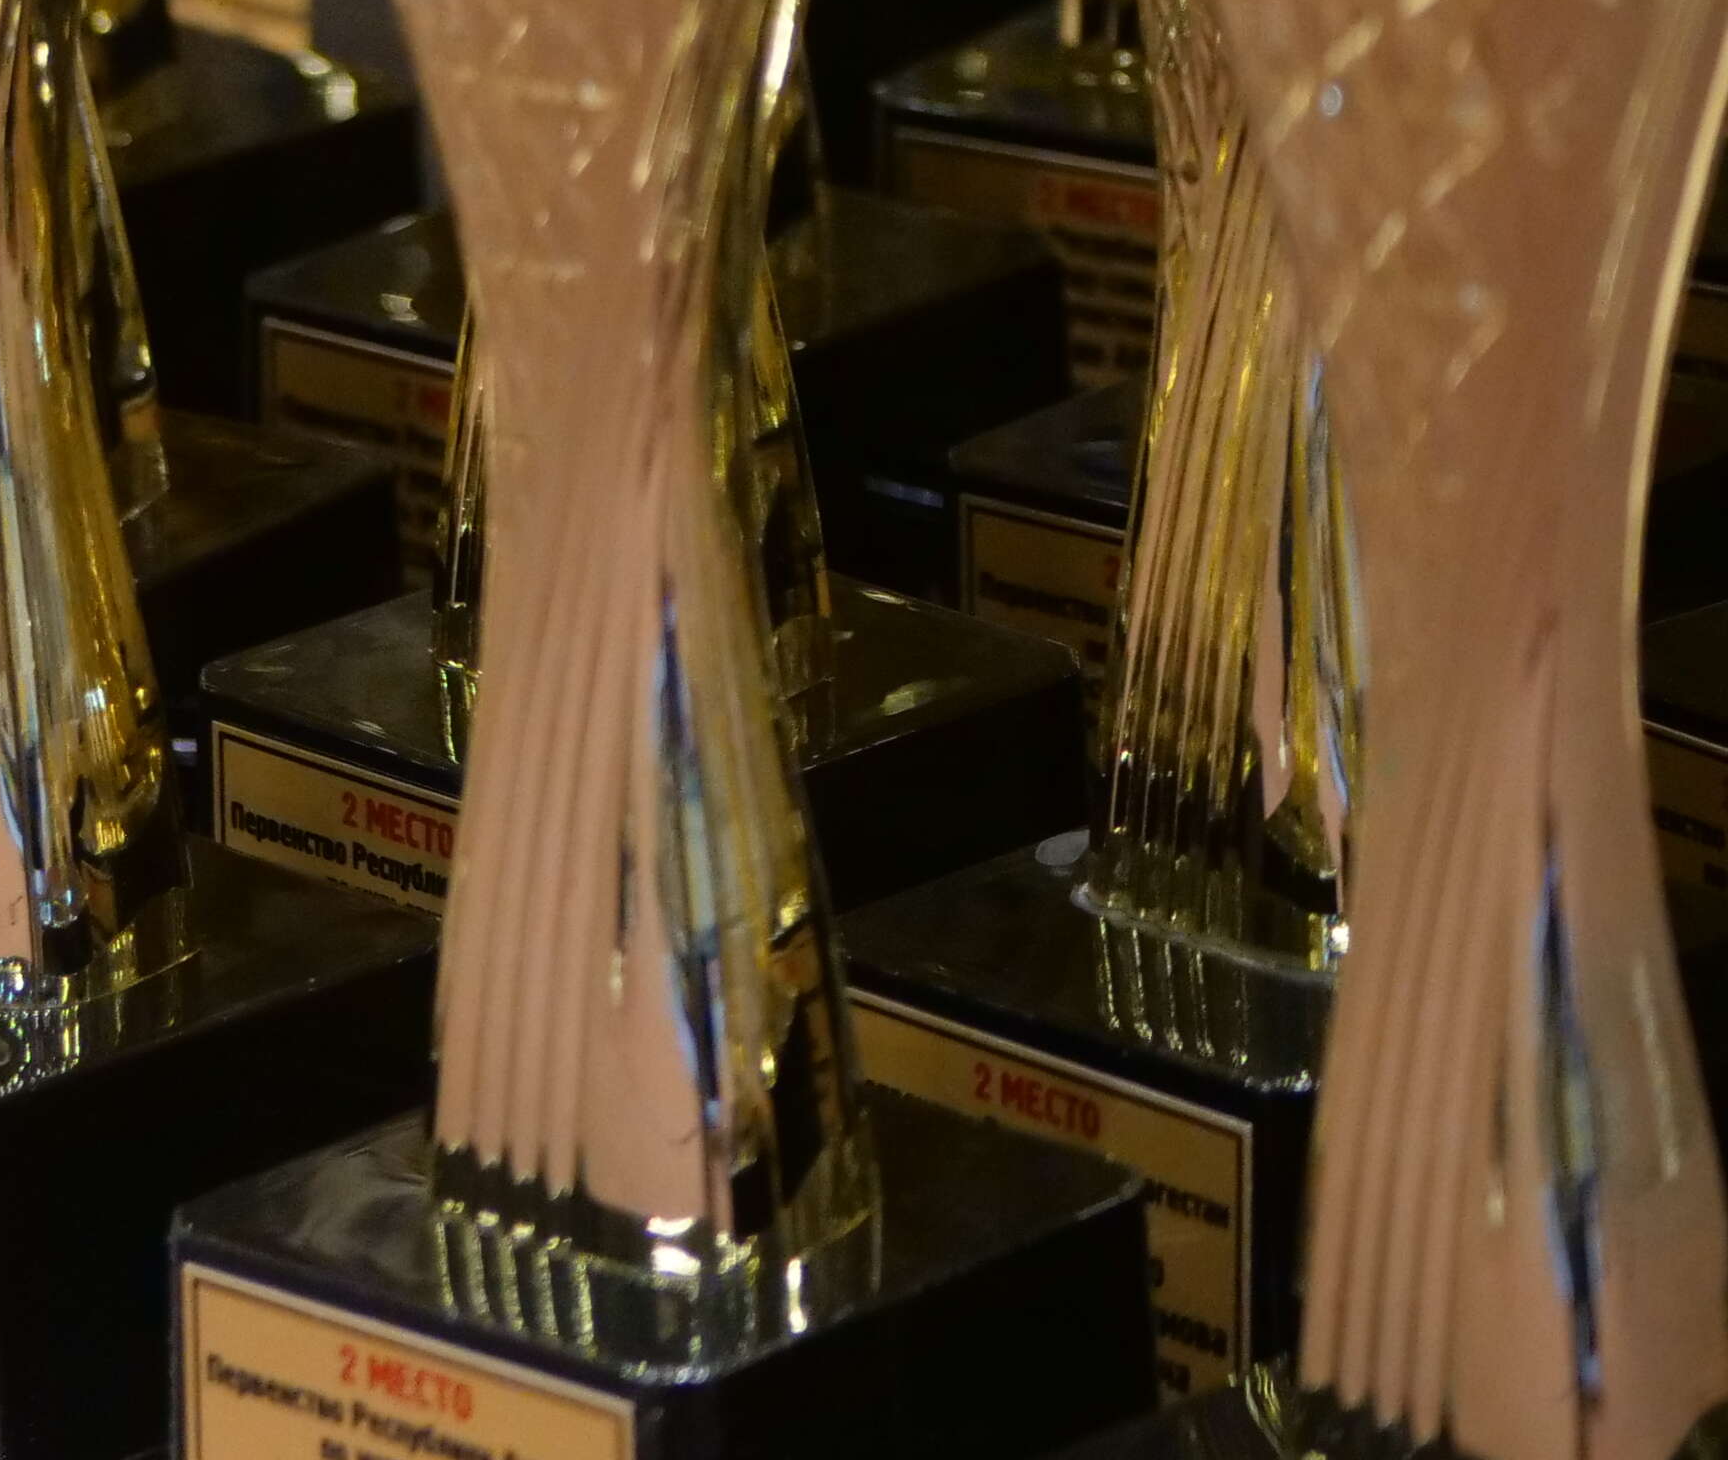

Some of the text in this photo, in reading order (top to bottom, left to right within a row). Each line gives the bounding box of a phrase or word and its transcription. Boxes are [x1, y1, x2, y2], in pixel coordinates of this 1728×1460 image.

[231, 801, 347, 865] Первенство
[352, 842, 448, 898] Республи
[342, 791, 453, 860] 2 МЕСТО
[974, 1062, 991, 1099] 2
[1001, 1071, 1101, 1139] МЕСТО
[368, 1355, 473, 1422] МЕСТО
